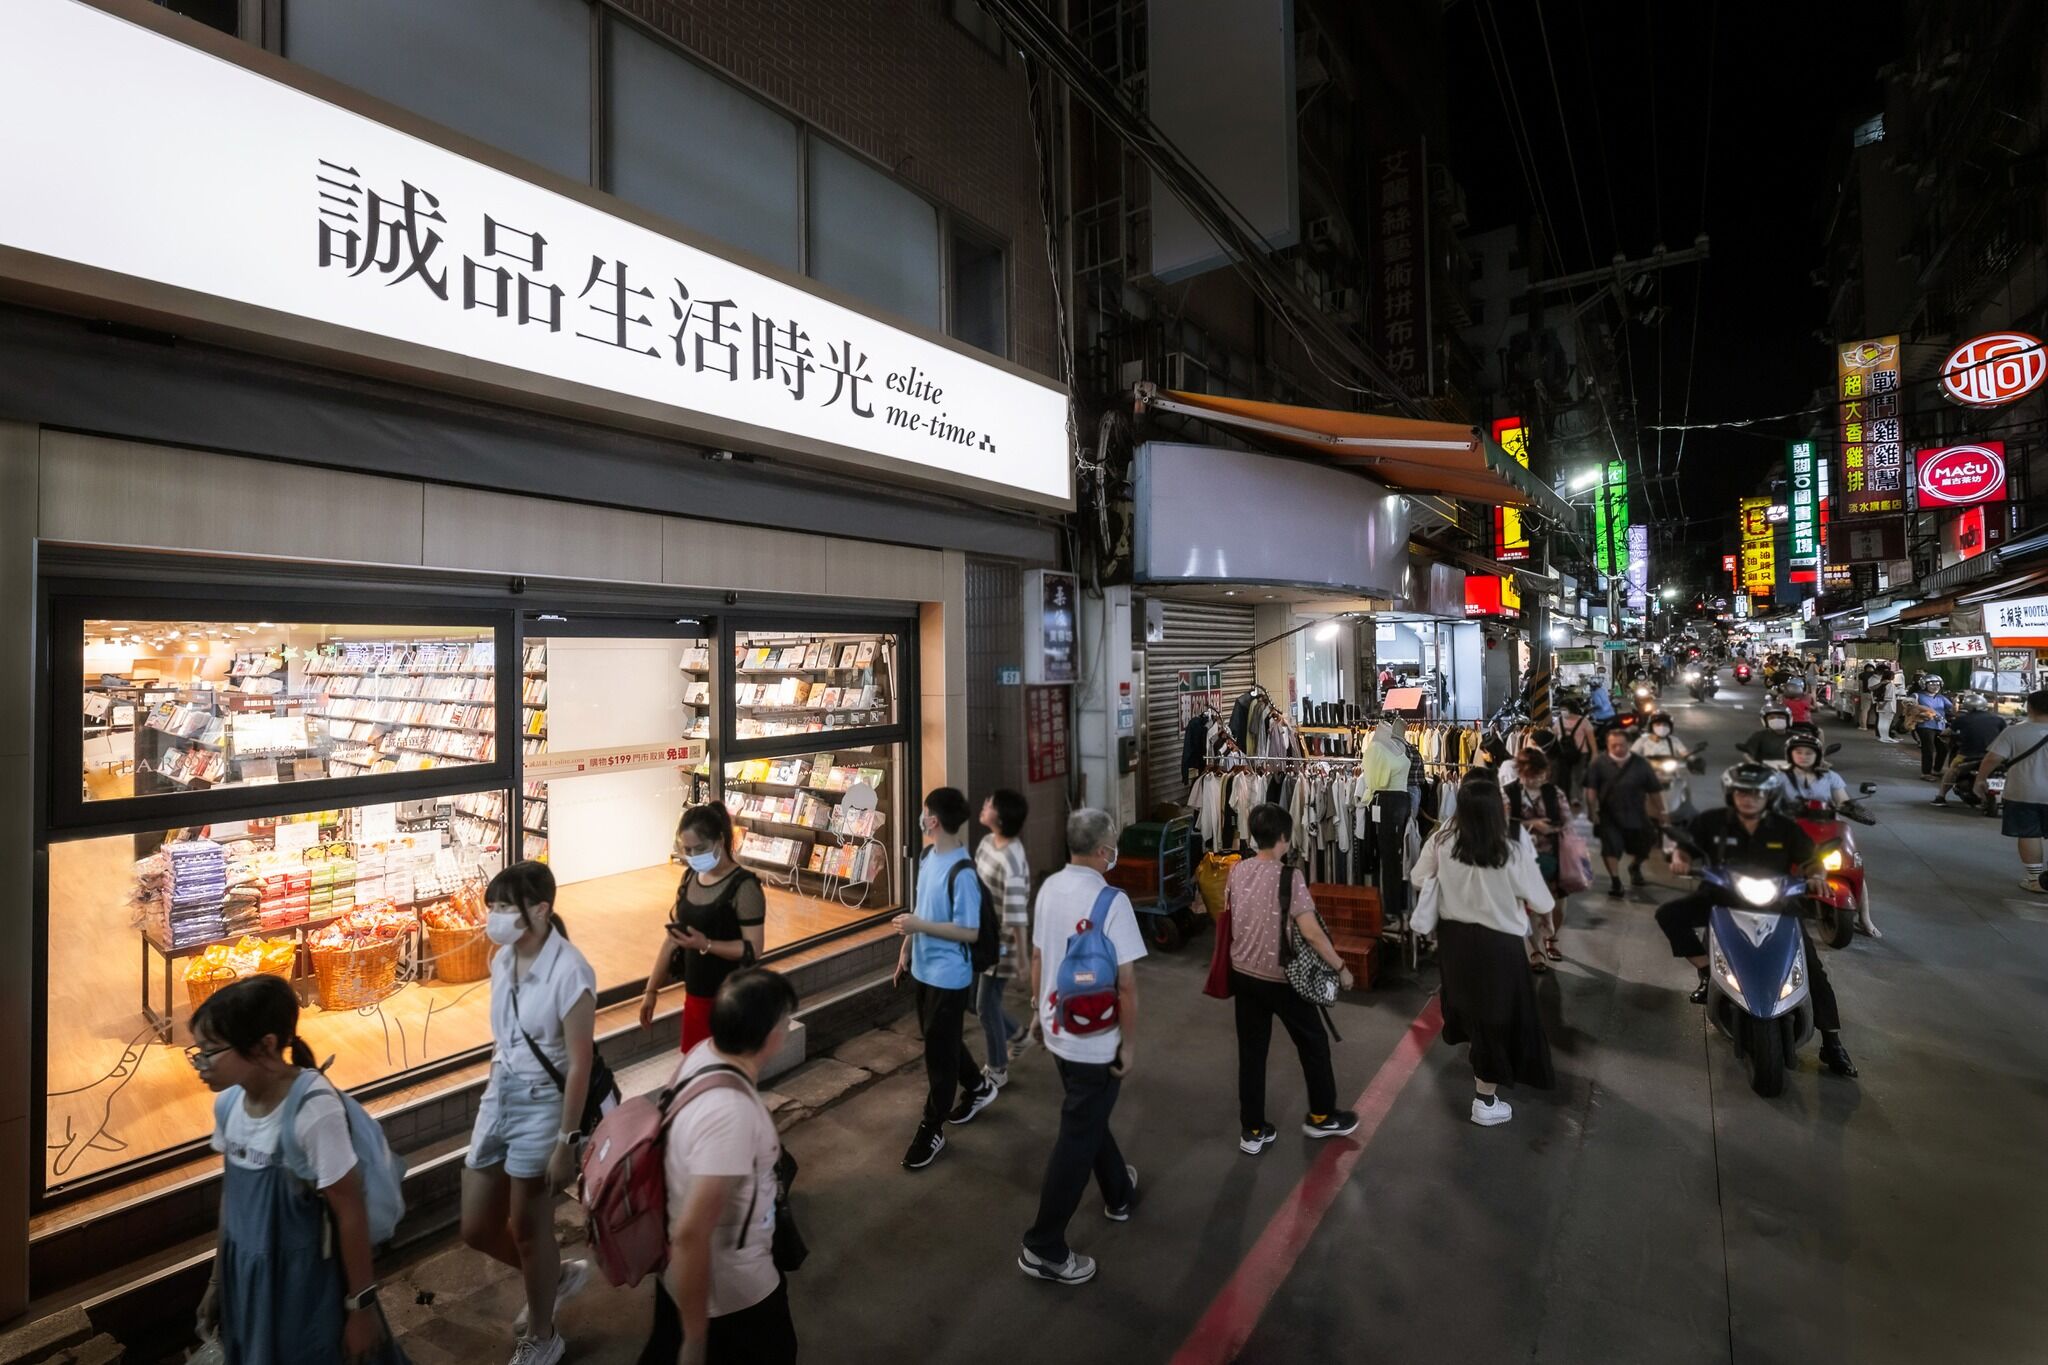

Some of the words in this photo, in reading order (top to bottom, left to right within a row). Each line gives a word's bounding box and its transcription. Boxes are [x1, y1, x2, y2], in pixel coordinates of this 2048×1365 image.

[316, 158, 875, 419] 誠品生活時光
[885, 366, 944, 406] eslite
[885, 402, 976, 448] me-time
[1844, 375, 1864, 493] 超大香雞排
[1872, 369, 1900, 492] 戰鬥雞雞幫
[1932, 639, 1984, 656] 鹽水雞
[101, 757, 154, 776] TEA
[279, 757, 298, 766] Food
